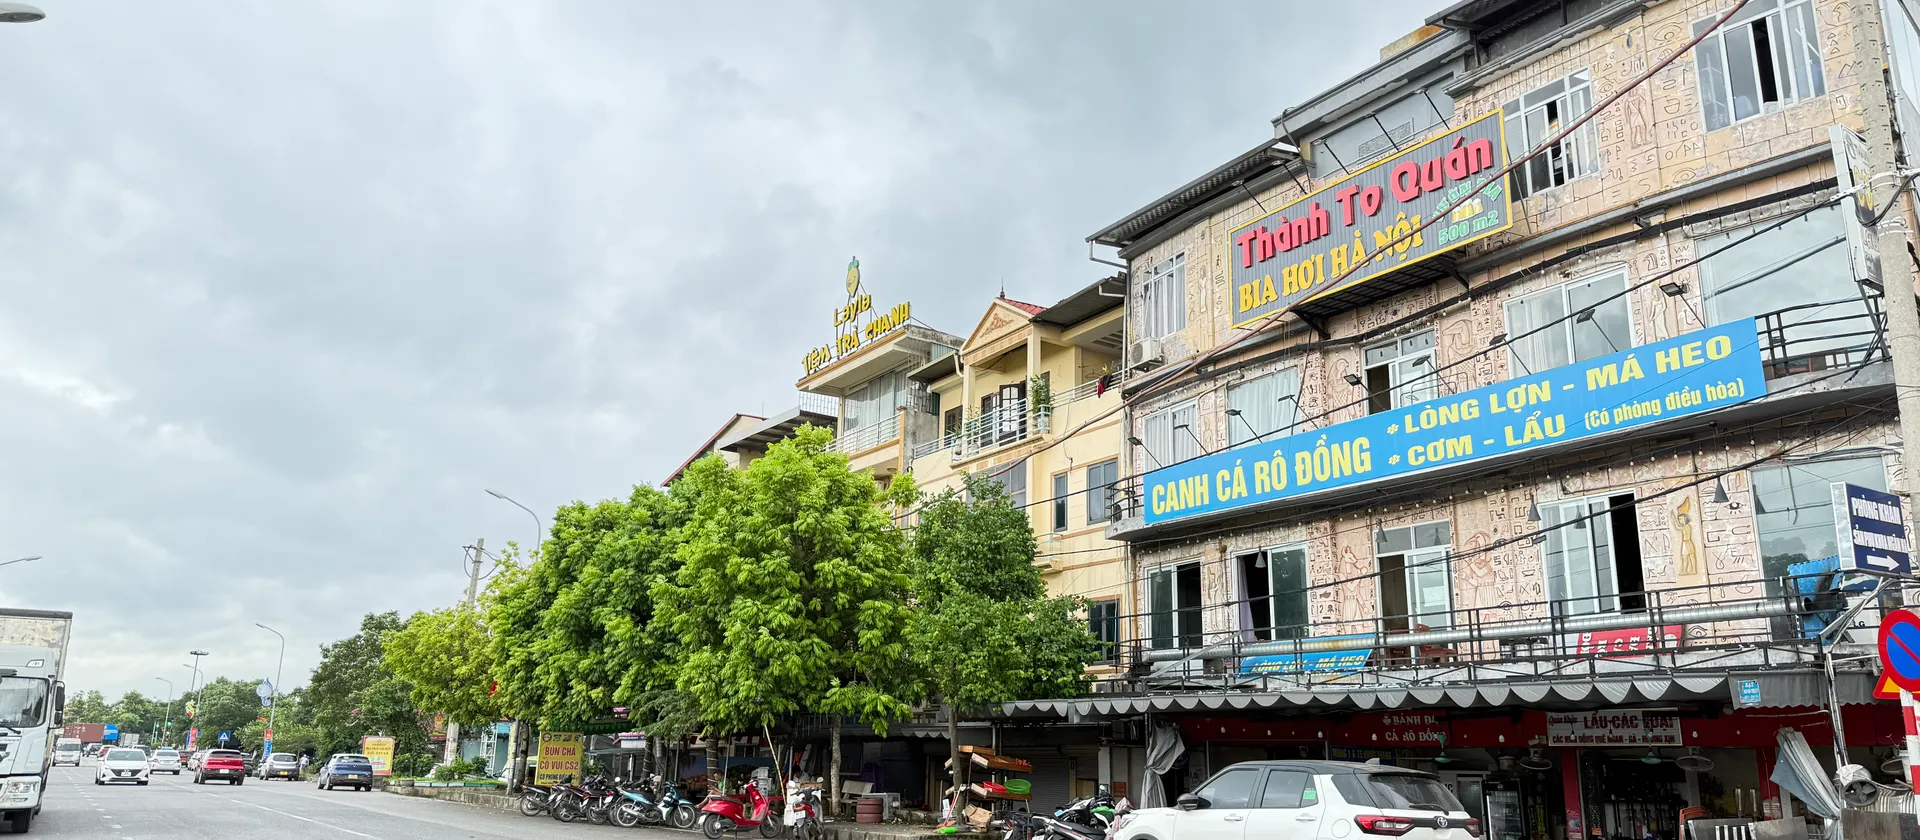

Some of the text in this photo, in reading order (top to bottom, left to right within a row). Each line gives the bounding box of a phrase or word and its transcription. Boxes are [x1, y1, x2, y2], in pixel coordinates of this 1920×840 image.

[1236, 137, 1494, 269] Thành To Quán
[1438, 210, 1499, 246] 500 m2
[1238, 211, 1424, 314] BIA HƠI HÀ NỘI
[833, 294, 872, 327] Layla
[801, 301, 911, 375] TIỆM TRÀ CHANH
[1404, 399, 1480, 434] LÒNG
[1489, 380, 1552, 414] LỢN
[1586, 353, 1645, 391] MÁ
[1655, 335, 1732, 374] HEO
[1407, 434, 1473, 466] CƠM
[1504, 410, 1566, 447] LẨU
[1584, 407, 1610, 431] (Có
[1613, 398, 1661, 425] phòng
[1665, 386, 1702, 411] điều
[1705, 377, 1746, 402] hòa)
[1152, 434, 1372, 515] CANH CÁ RÔ ĐỒNG
[1851, 494, 1902, 525] PHÒNG KHÁM
[1385, 728, 1400, 742] CÁ
[1402, 729, 1416, 742] RÔ
[1392, 712, 1421, 725] BÁNH
[1611, 712, 1639, 729] CÁC
[545, 745, 559, 756] BÚN
[551, 760, 563, 770] VUI
[564, 761, 579, 770] CS2
